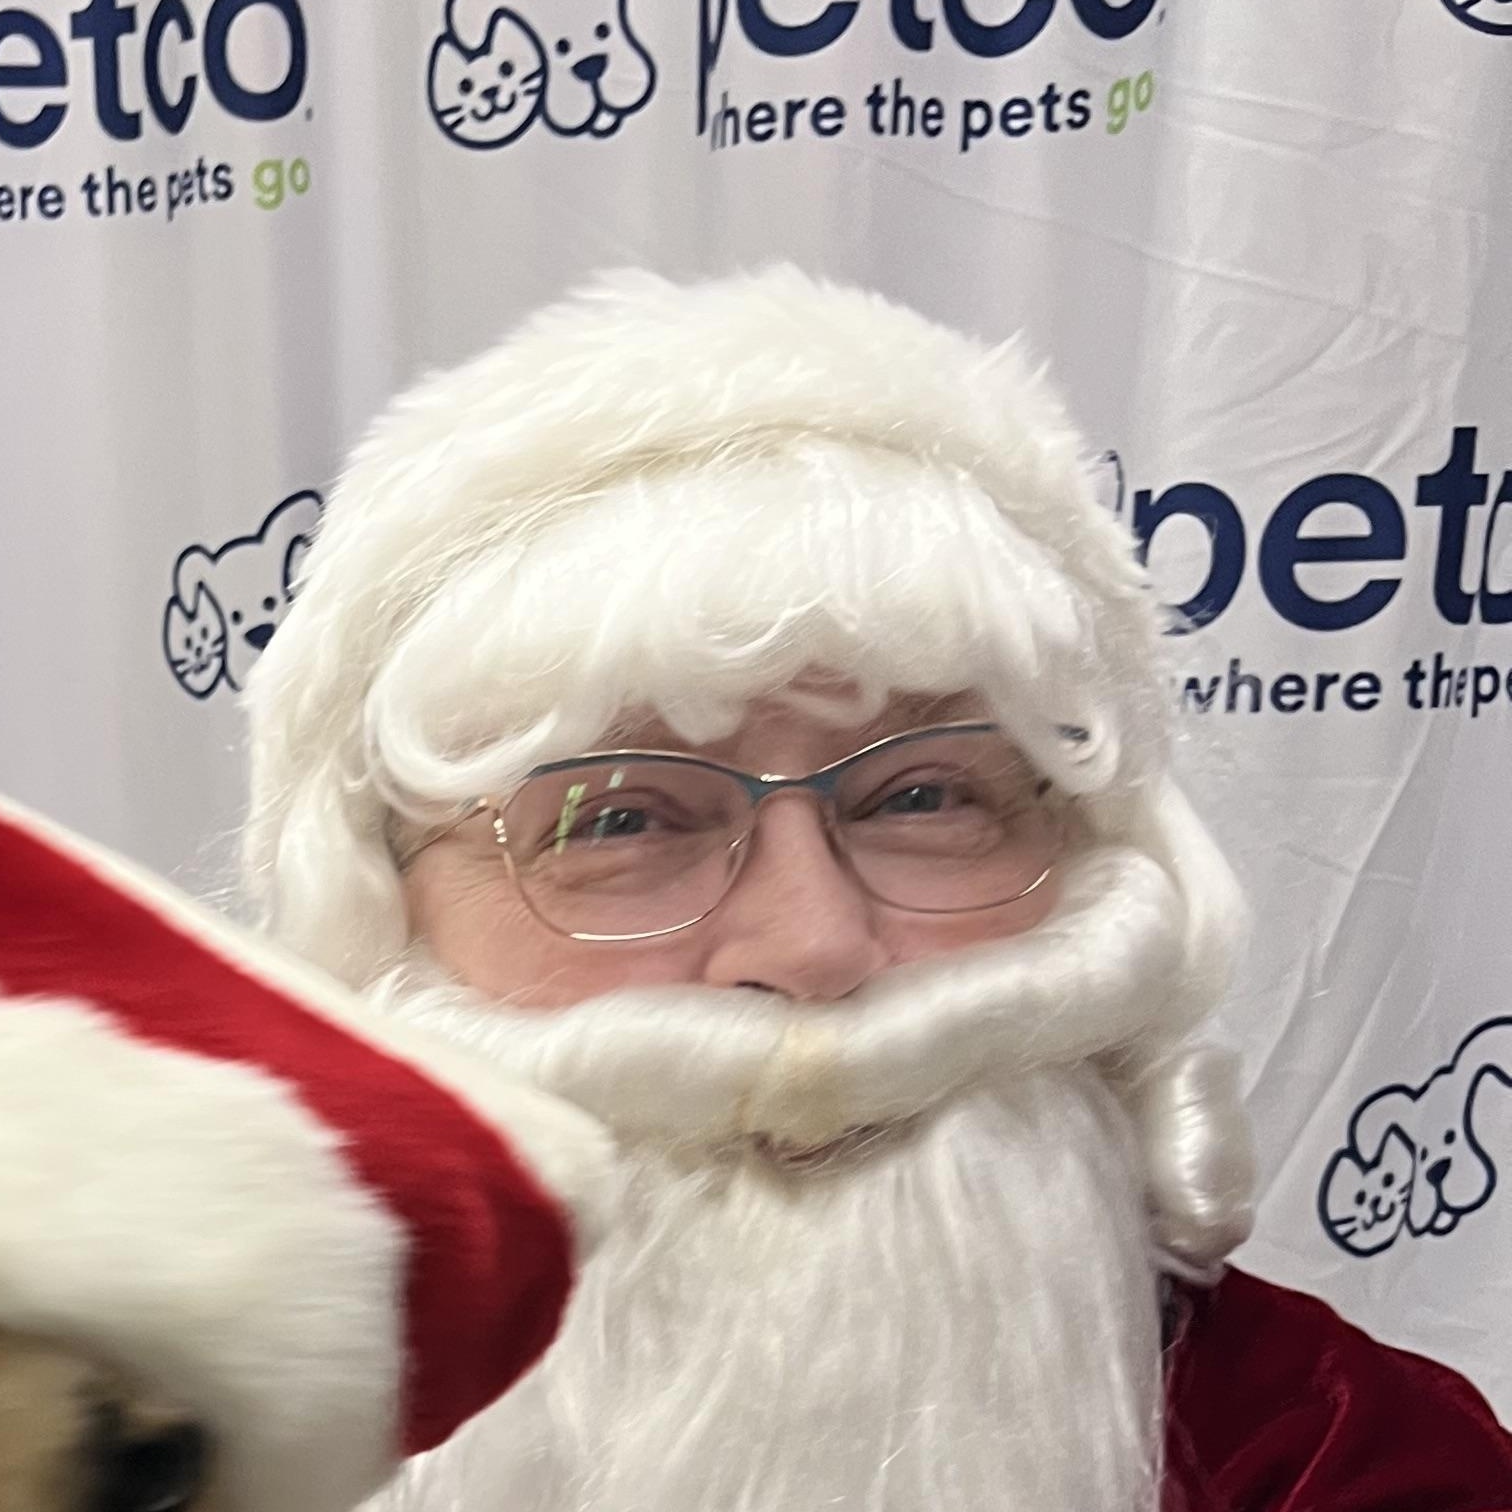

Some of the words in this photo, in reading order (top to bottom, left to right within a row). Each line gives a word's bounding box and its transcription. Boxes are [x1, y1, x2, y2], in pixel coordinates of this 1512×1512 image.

[712, 91, 846, 151] here
[866, 78, 945, 137] the
[960, 83, 1091, 153] pets
[1106, 70, 1154, 134] go
[80, 167, 157, 217] the
[166, 158, 234, 221] pets
[252, 157, 311, 209] go
[1403, 652, 1468, 710] the
